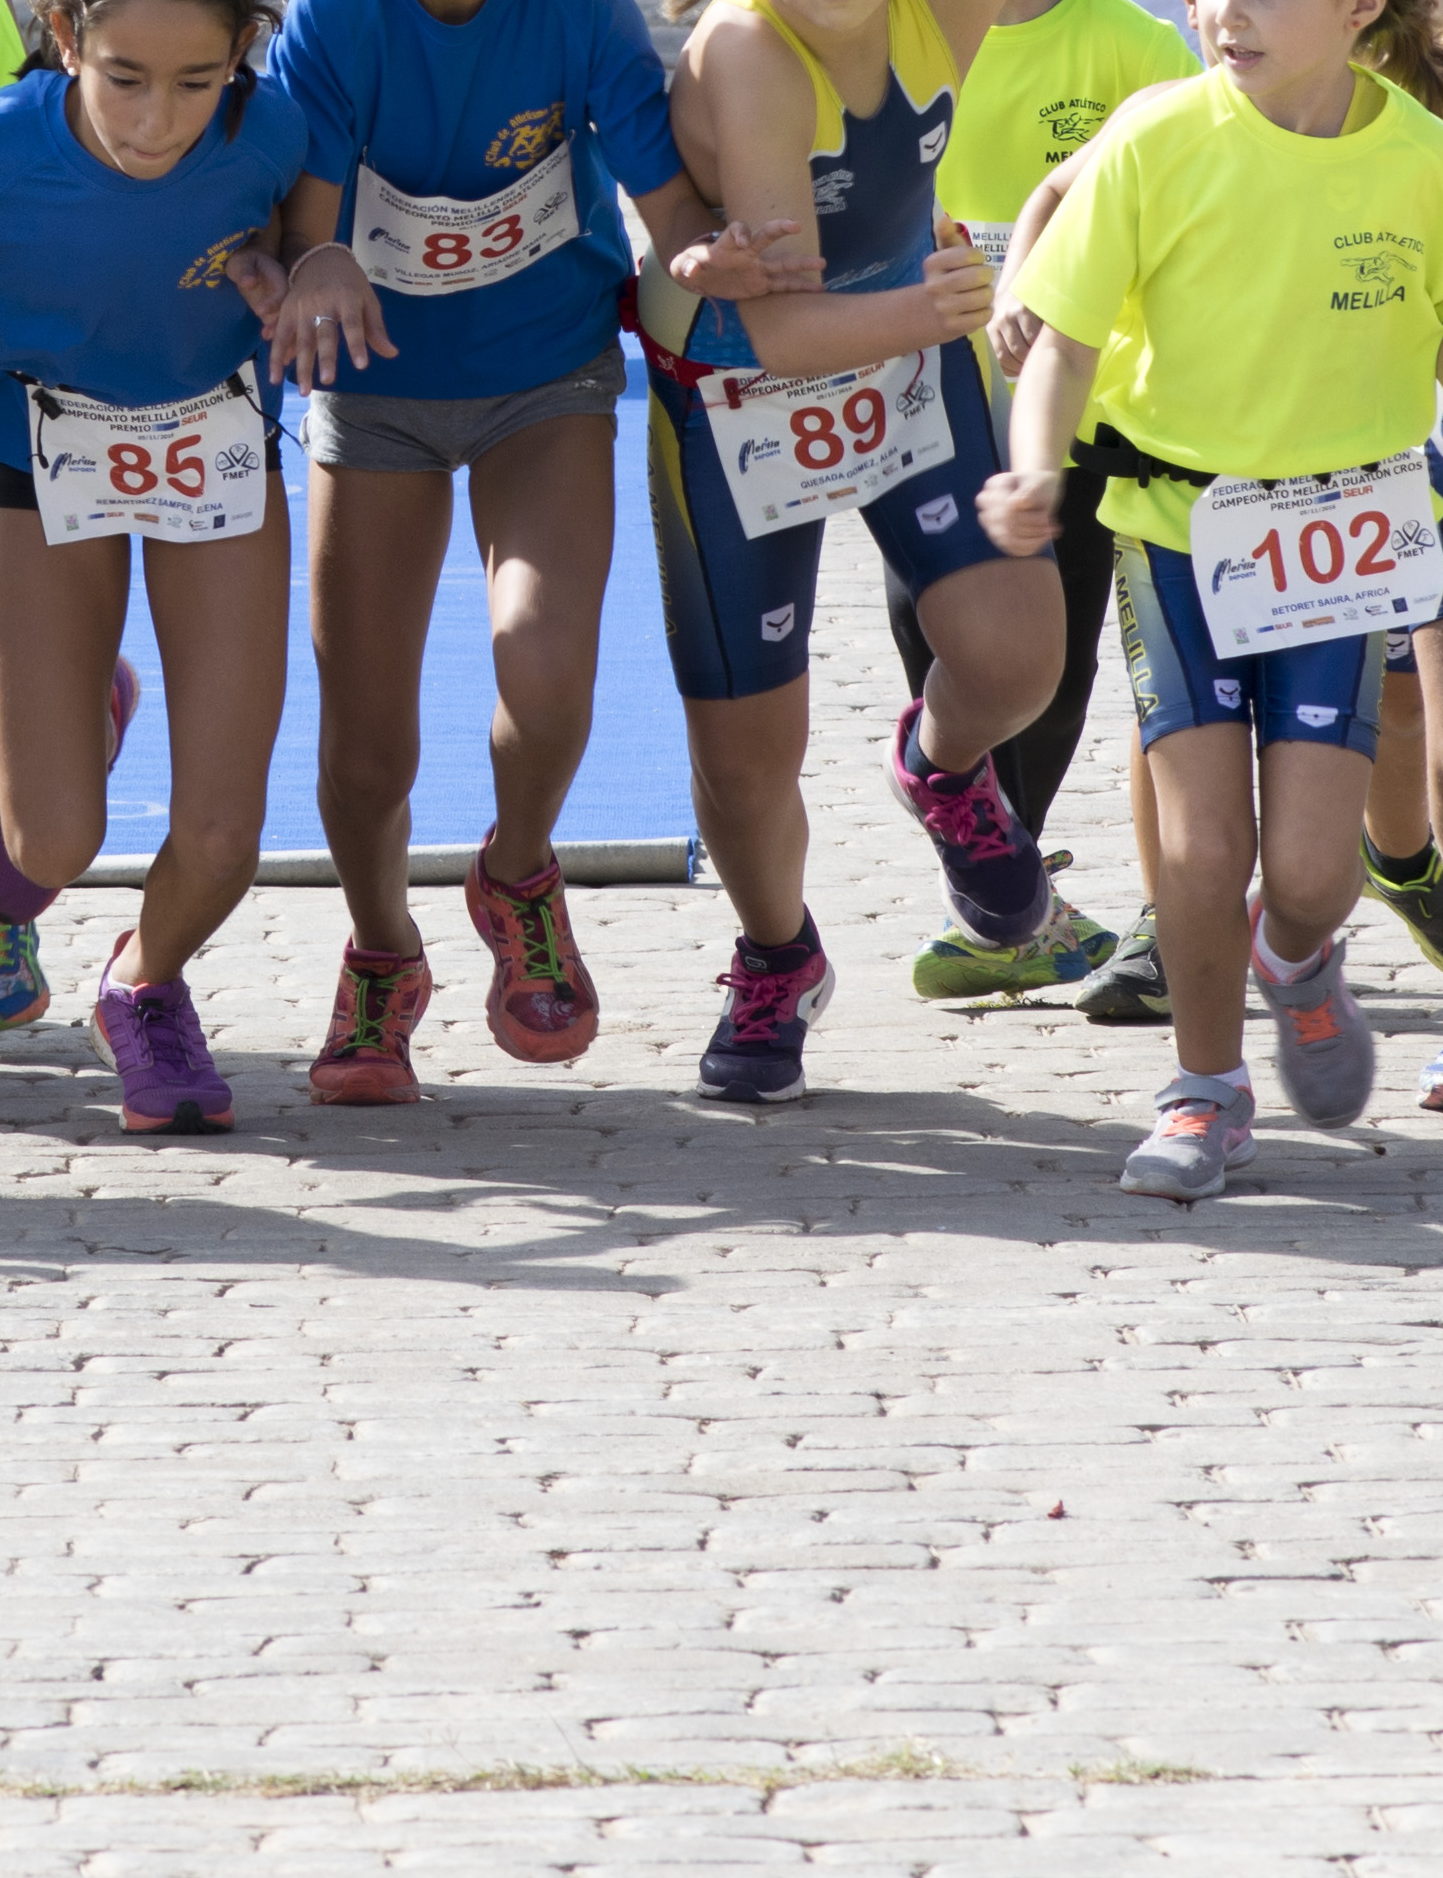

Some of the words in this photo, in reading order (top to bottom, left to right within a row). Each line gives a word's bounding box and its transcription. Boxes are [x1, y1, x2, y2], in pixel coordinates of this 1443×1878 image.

[1039, 101, 1066, 118] CLUB
[1068, 97, 1107, 113] ATLÉTICO
[379, 193, 451, 221] CAMPEONATO
[453, 204, 500, 221] MELILLA
[380, 186, 448, 214] FEDERACIÓN
[422, 214, 524, 270] 83
[1334, 231, 1373, 250] CLUB
[1330, 285, 1405, 311] MELILLA
[787, 382, 828, 399] PREMIO
[858, 361, 885, 379] SEUR
[61, 408, 128, 422] AMPEONATO
[131, 410, 178, 423] MELILLA
[179, 395, 224, 415] DUATLON
[110, 424, 151, 432] PREMIO
[181, 412, 208, 426] SEUR
[790, 387, 886, 470] 89
[107, 434, 205, 498] 85
[222, 470, 250, 481] FMET
[800, 472, 845, 490] QUESADA
[880, 446, 899, 463] ALBA
[1212, 488, 1289, 511] CAMPEONATO
[1292, 481, 1340, 498] MELILLA
[1341, 470, 1392, 487] DUATLON
[1393, 461, 1423, 475] CROS
[1270, 498, 1313, 512] PREMIO
[1342, 485, 1374, 499] SEUR
[1251, 510, 1396, 593] 102
[1397, 546, 1425, 561] FMET
[1271, 600, 1316, 617] BETORET
[1355, 586, 1390, 602] AFRICA
